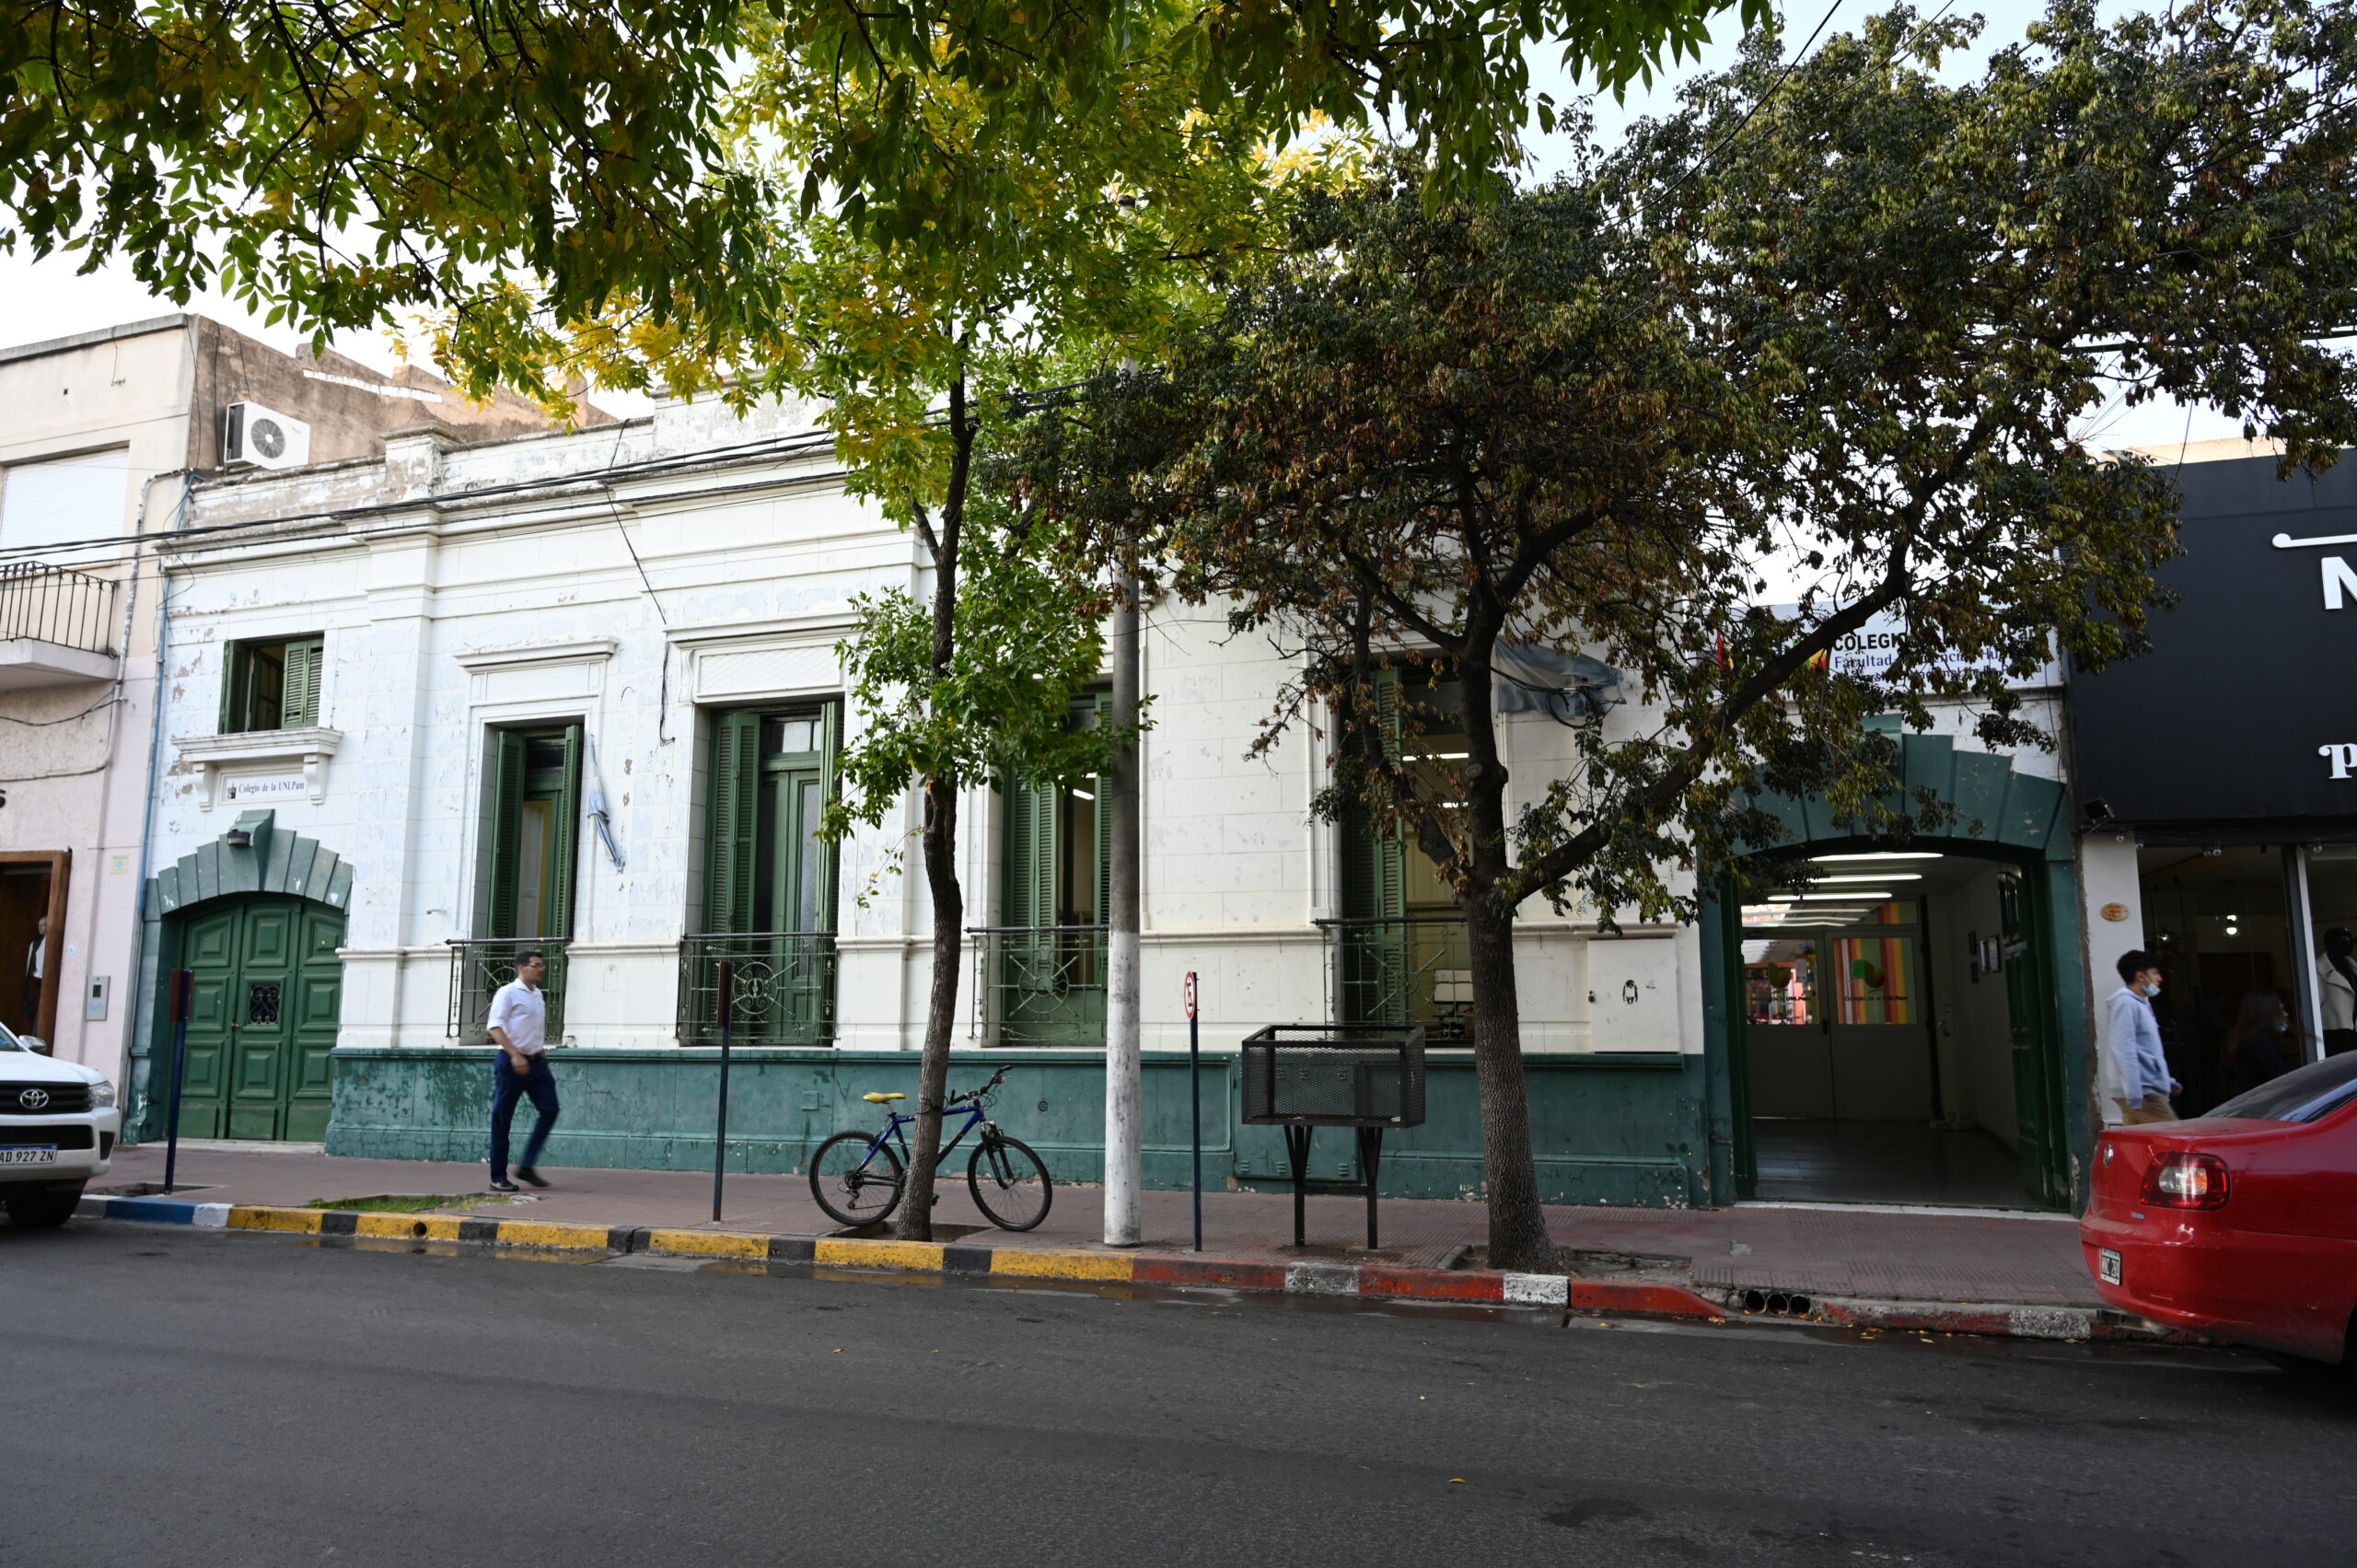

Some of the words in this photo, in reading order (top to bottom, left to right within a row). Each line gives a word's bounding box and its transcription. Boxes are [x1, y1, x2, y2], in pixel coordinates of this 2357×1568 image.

[238, 783, 261, 794] Colegio
[261, 783, 269, 792] de
[271, 782, 276, 791] la
[278, 781, 305, 791] UNLPam
[0, 1151, 13, 1163] AD
[16, 1151, 37, 1163] 927
[40, 1150, 54, 1162] ZN
